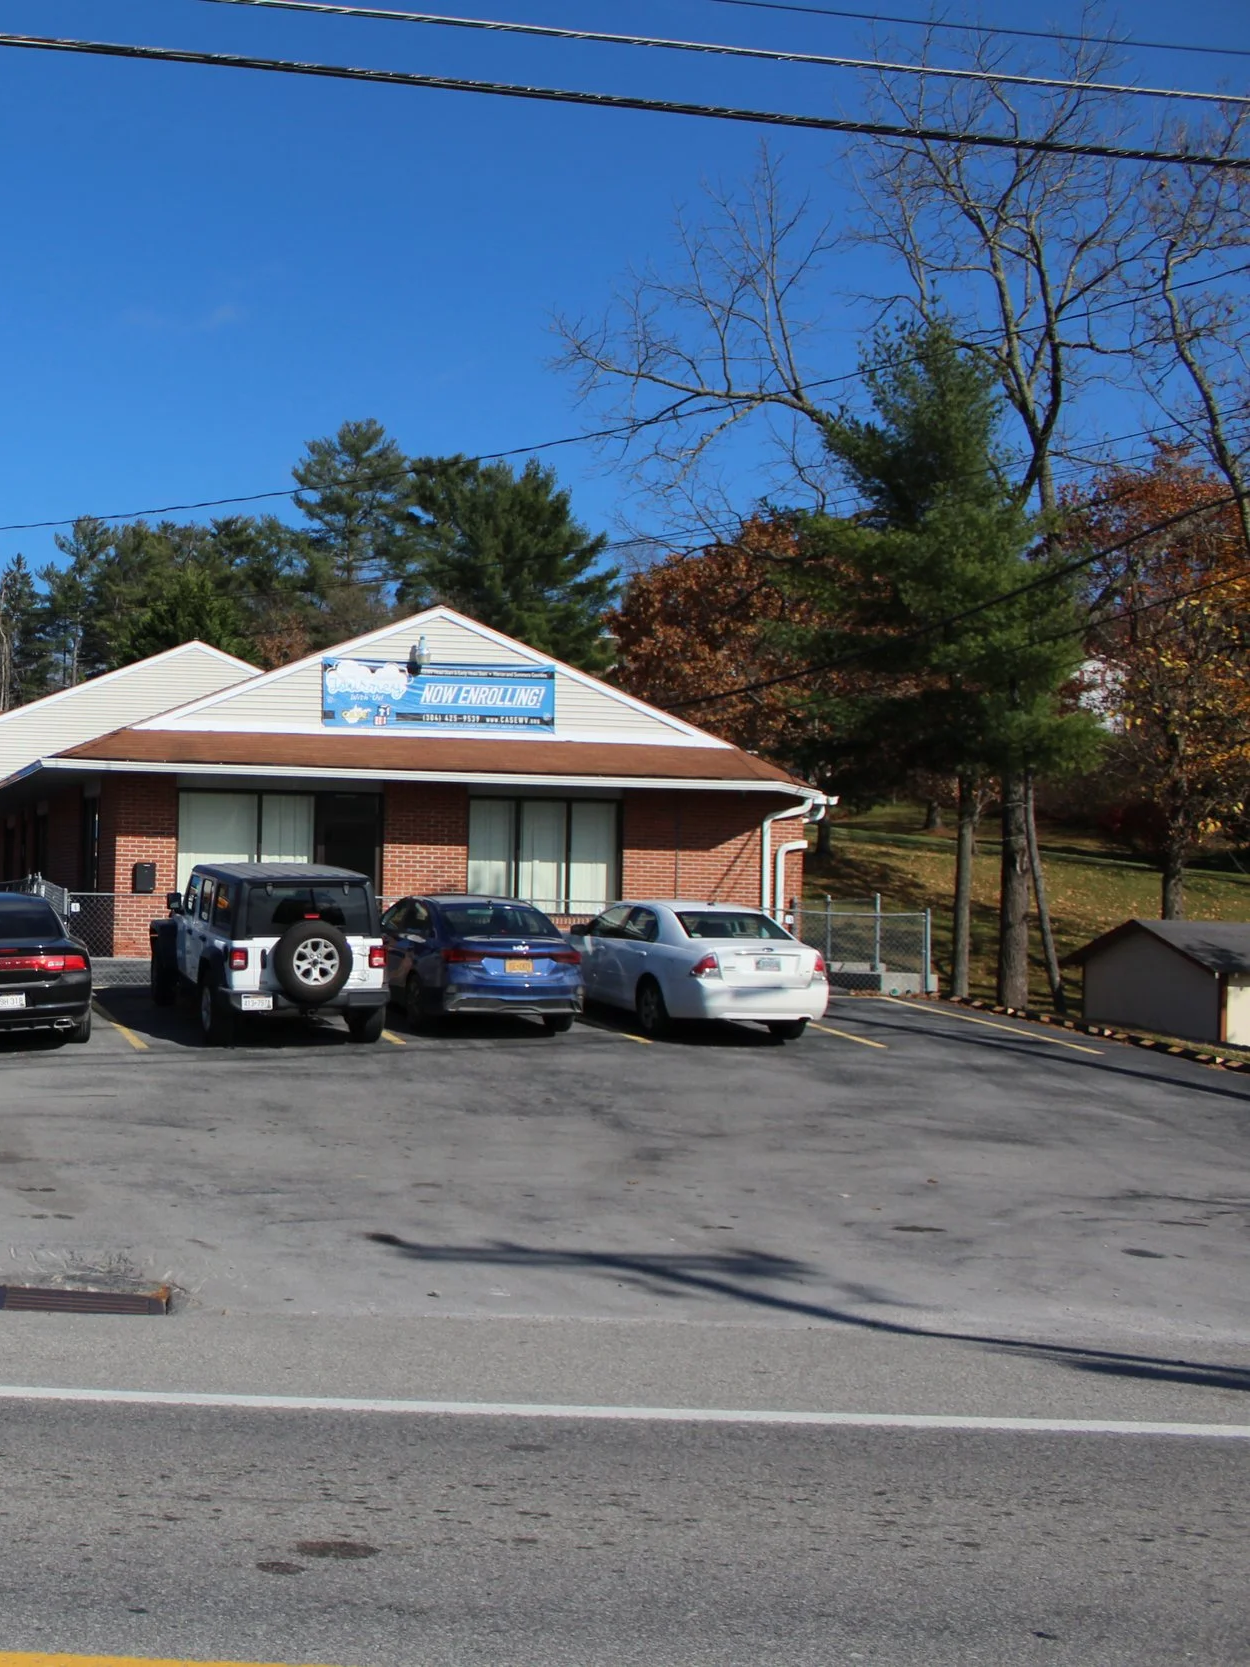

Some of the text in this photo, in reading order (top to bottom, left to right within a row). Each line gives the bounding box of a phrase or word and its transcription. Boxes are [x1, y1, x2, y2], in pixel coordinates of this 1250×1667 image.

[421, 685, 545, 706] NOW ENROLLING!
[422, 714, 442, 723] (304)
